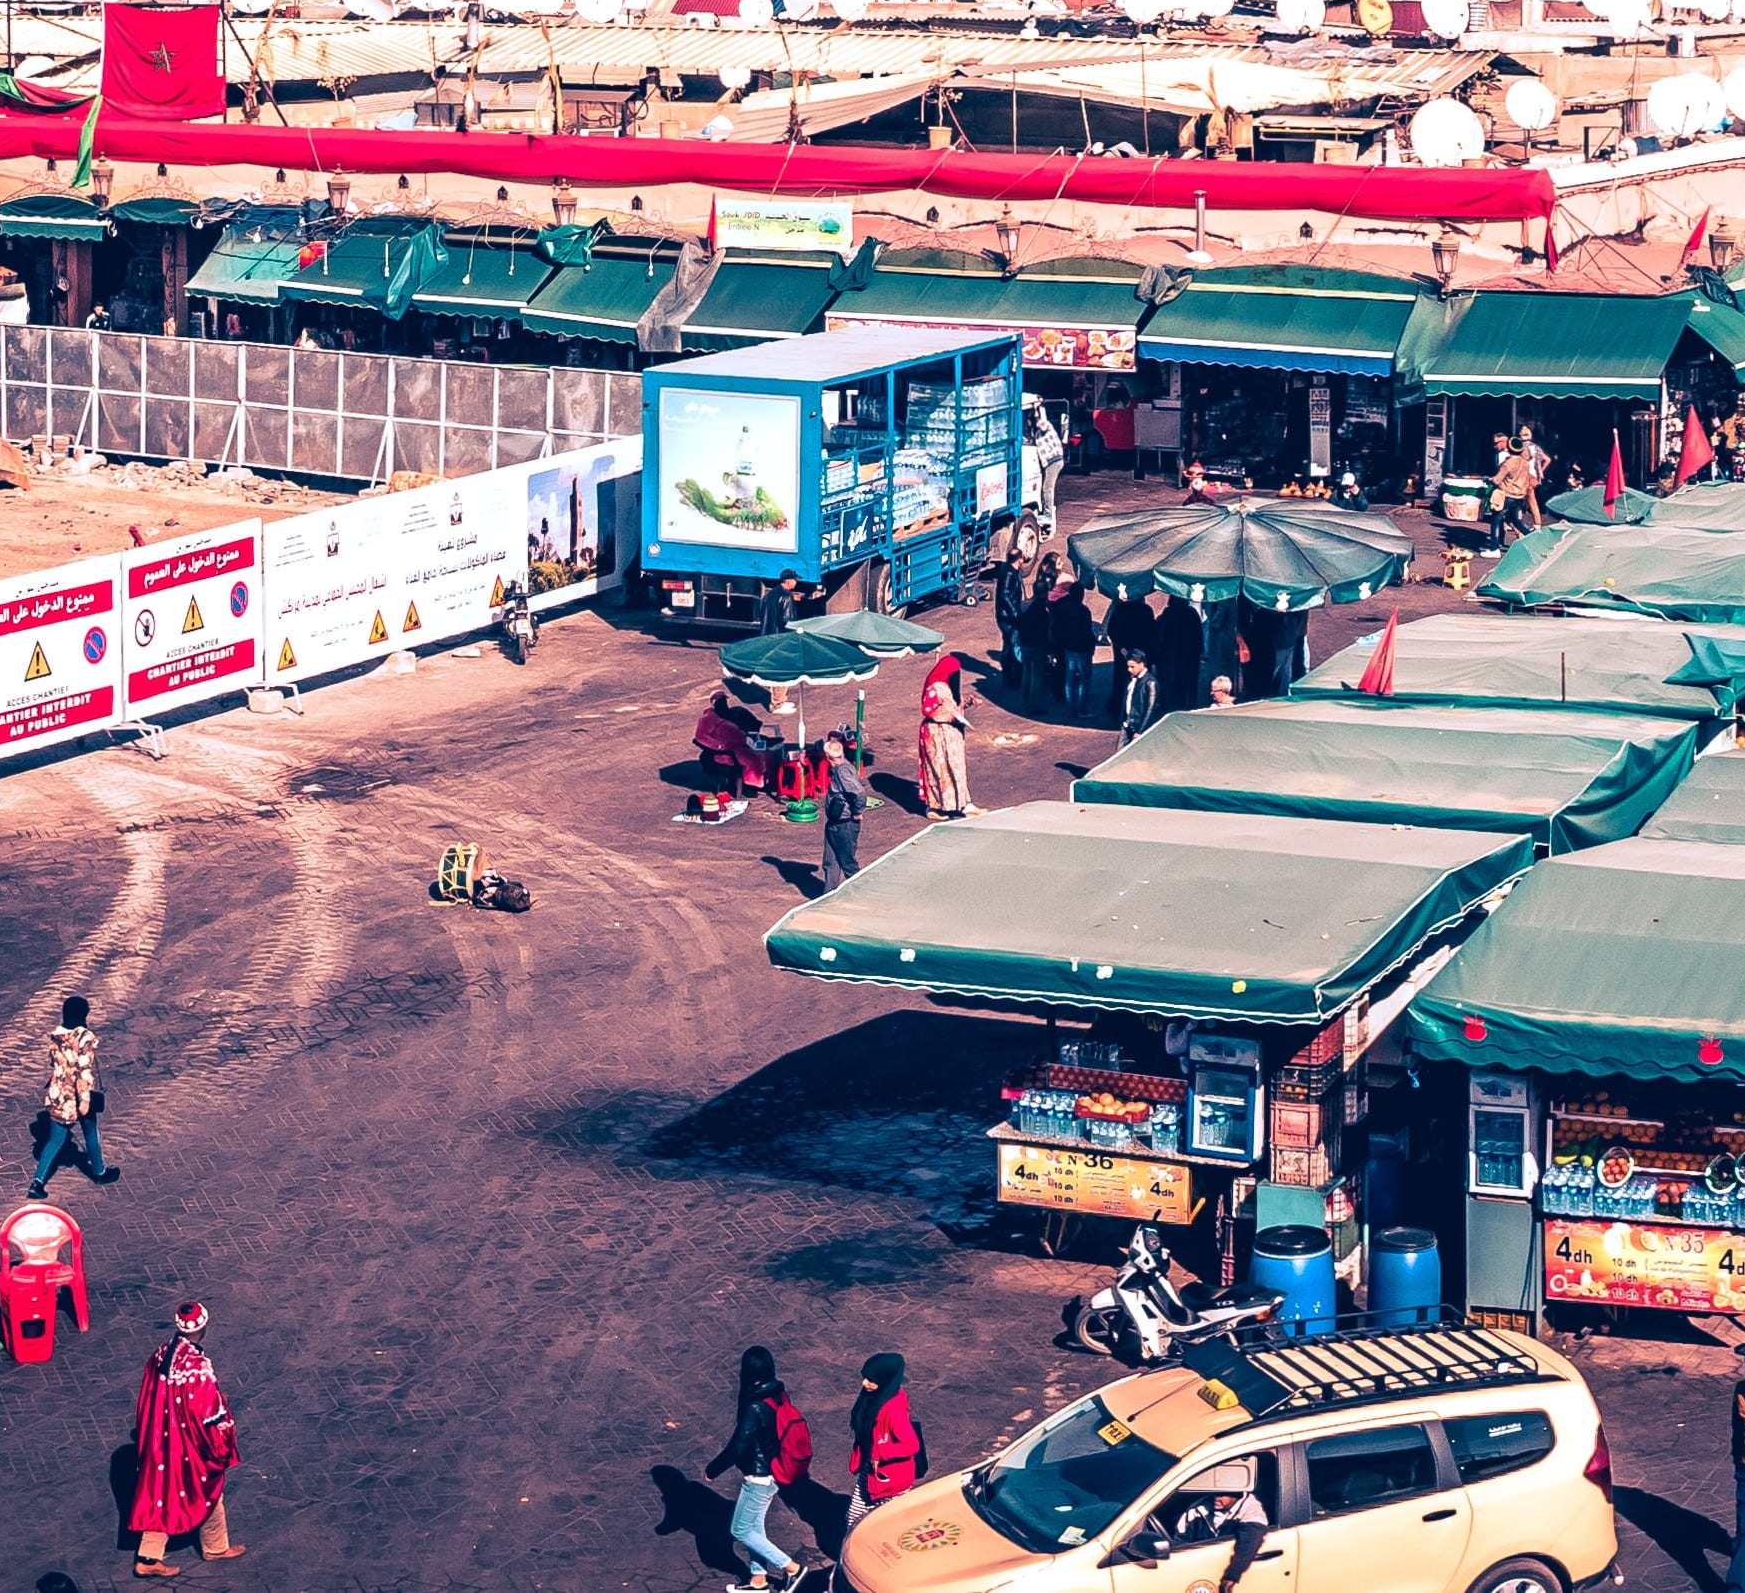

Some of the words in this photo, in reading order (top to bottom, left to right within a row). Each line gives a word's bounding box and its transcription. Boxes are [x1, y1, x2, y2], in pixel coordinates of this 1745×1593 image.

[172, 560, 187, 579] على
[188, 552, 215, 574] الدخول
[216, 550, 240, 569] ممنوع
[144, 563, 171, 589] العموم
[31, 595, 64, 619] الدخول
[66, 592, 95, 613] ممنوع
[12, 604, 29, 624] على
[147, 657, 192, 681] CHANTIER
[194, 646, 236, 666] INTERDIT
[168, 674, 180, 687] AU
[182, 665, 216, 683] PUBLIC
[41, 694, 92, 718] INTERDIT
[9, 723, 25, 737] AU
[27, 713, 67, 733] PUBLIC
[1065, 1168, 1074, 1176] dh
[1054, 1182, 1063, 1190] 10
[1065, 1183, 1074, 1191] dh
[1065, 1196, 1074, 1204] dh
[1612, 1258, 1624, 1267] 10
[1626, 1258, 1637, 1268] dh
[1612, 1273, 1624, 1282] 10
[1627, 1273, 1638, 1283] dh
[1612, 1288, 1625, 1298] 10
[1627, 1289, 1639, 1299] dh
[1202, 1386, 1221, 1406] TAXI
[1107, 1423, 1125, 1441] TAXI
